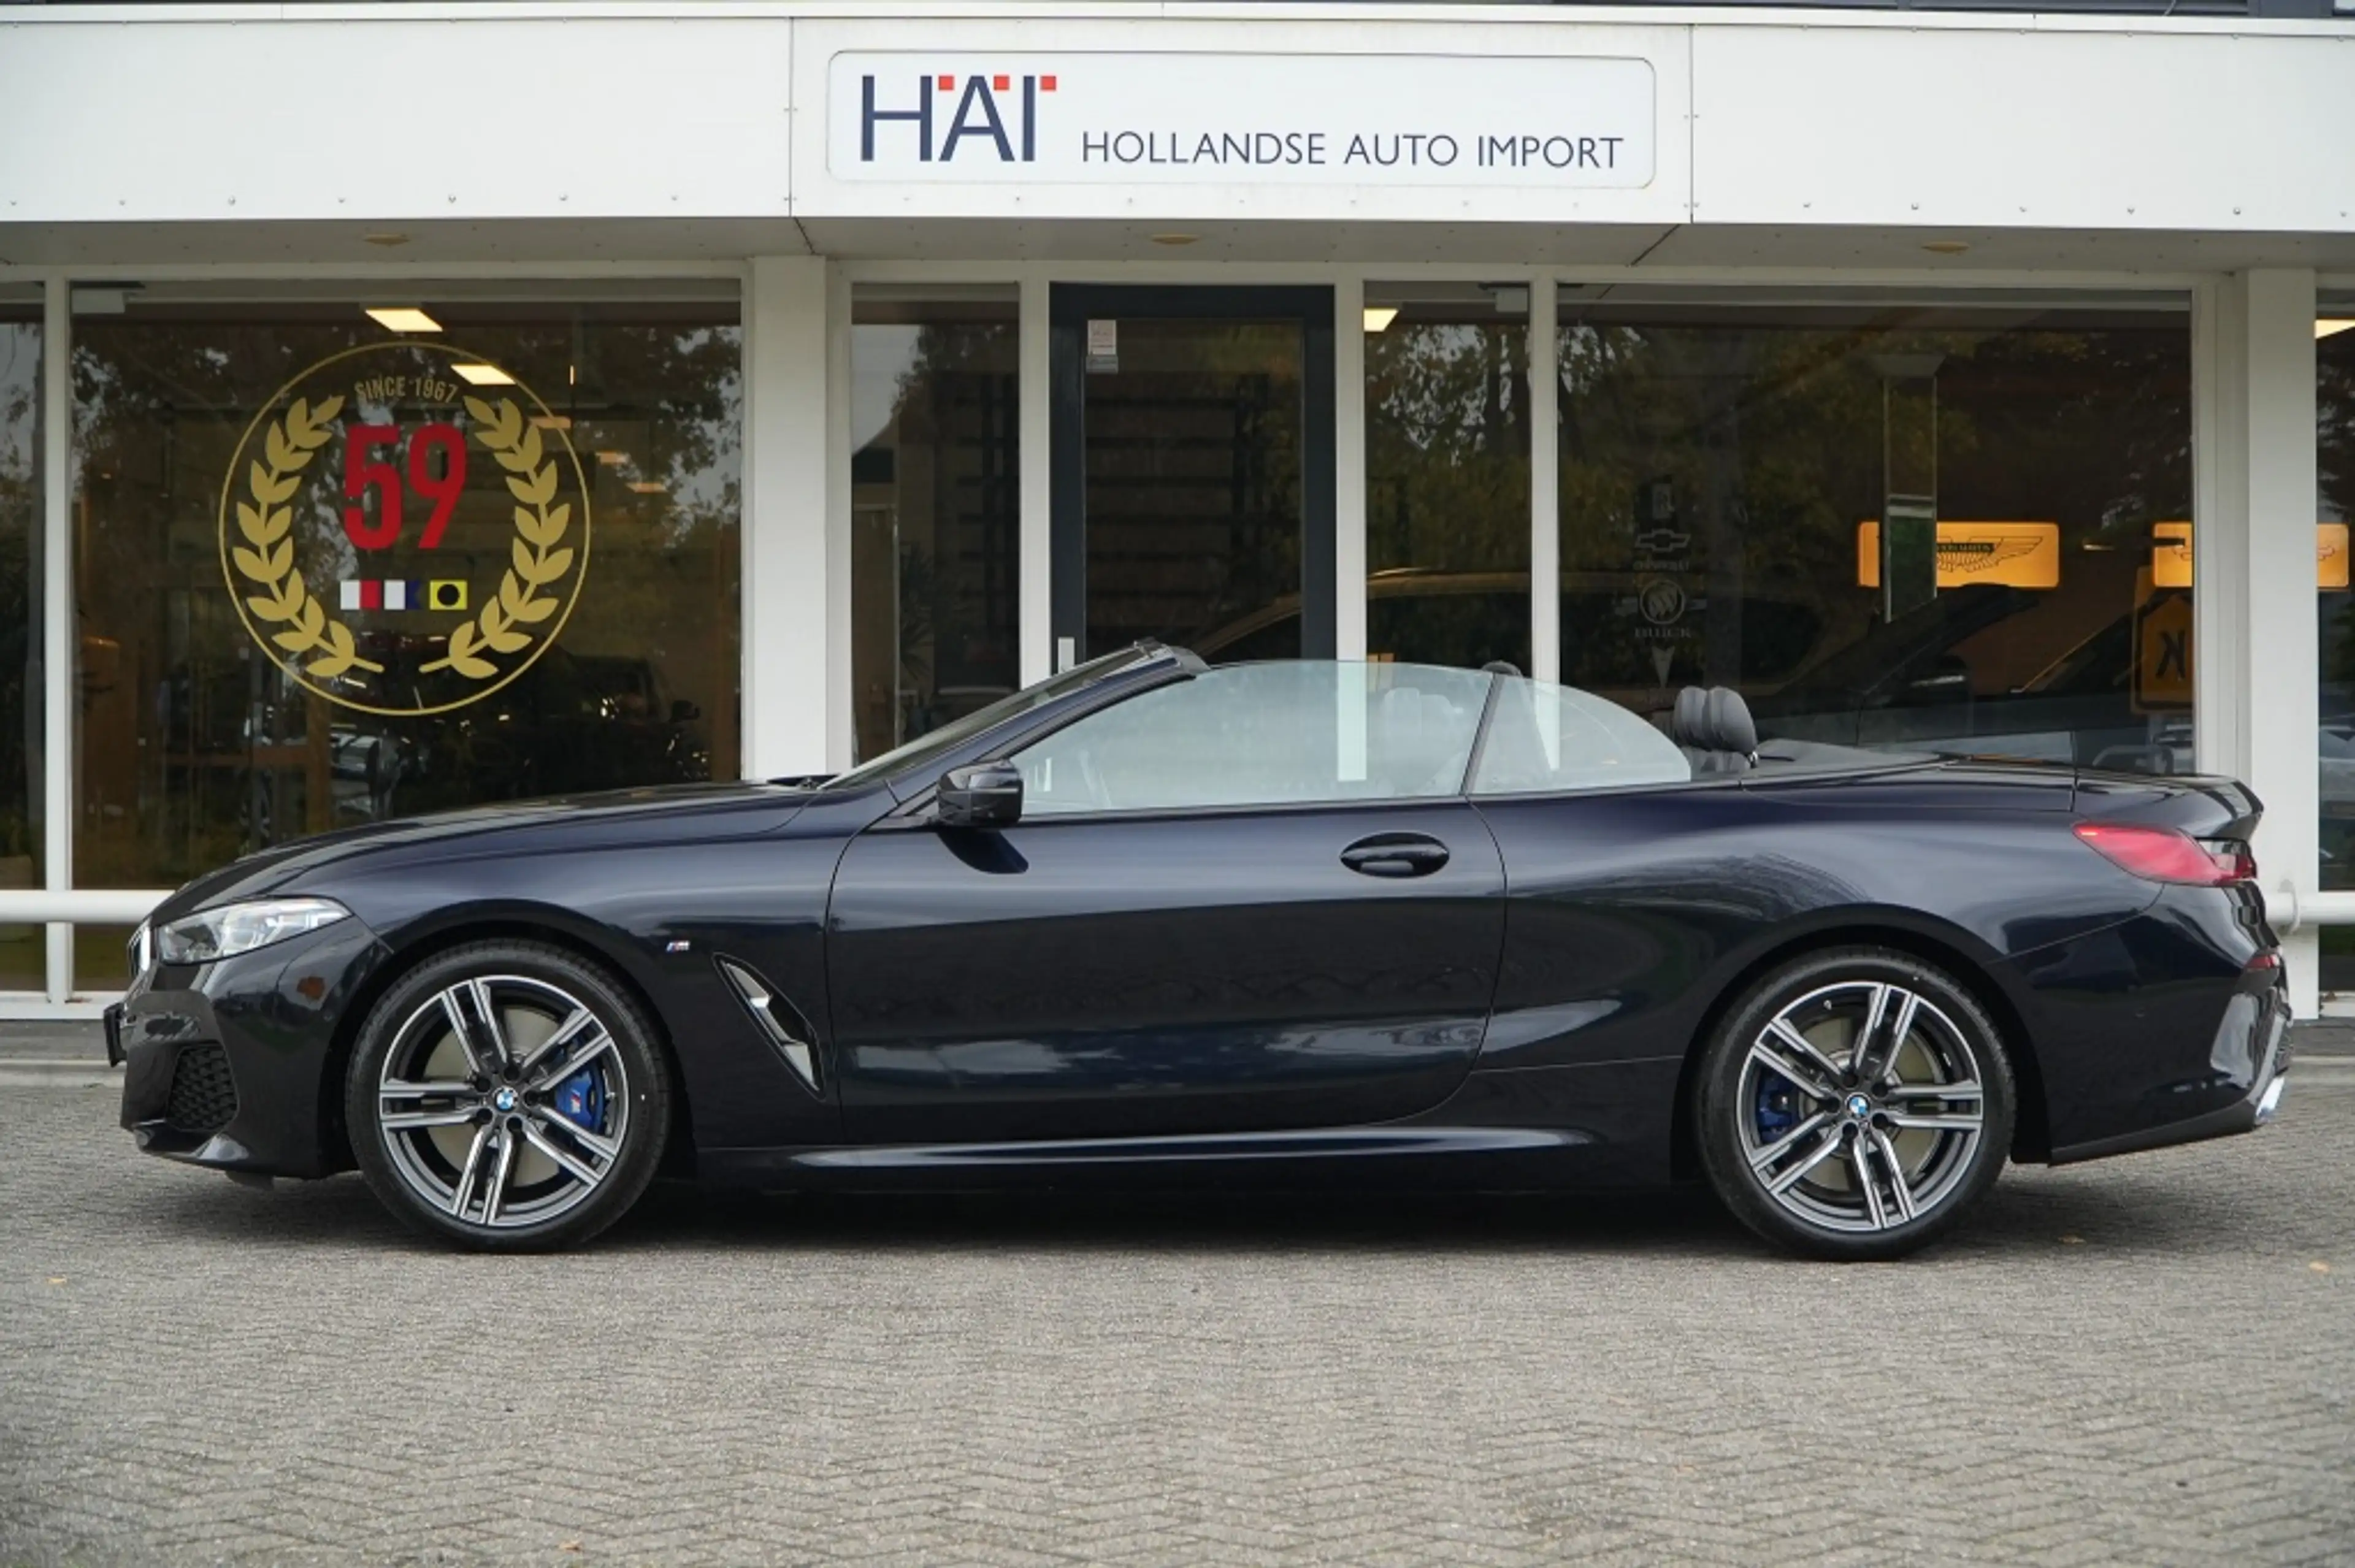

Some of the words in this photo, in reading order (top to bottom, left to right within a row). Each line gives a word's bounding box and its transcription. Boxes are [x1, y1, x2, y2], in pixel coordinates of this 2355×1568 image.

[860, 75, 1037, 162] HAI
[1082, 131, 1326, 164] HOLLANDSE
[1344, 134, 1458, 166] AUTO
[1479, 136, 1624, 168] IMPORT
[354, 376, 406, 401] SINCE
[415, 377, 459, 403] 1967
[343, 423, 467, 549] 59
